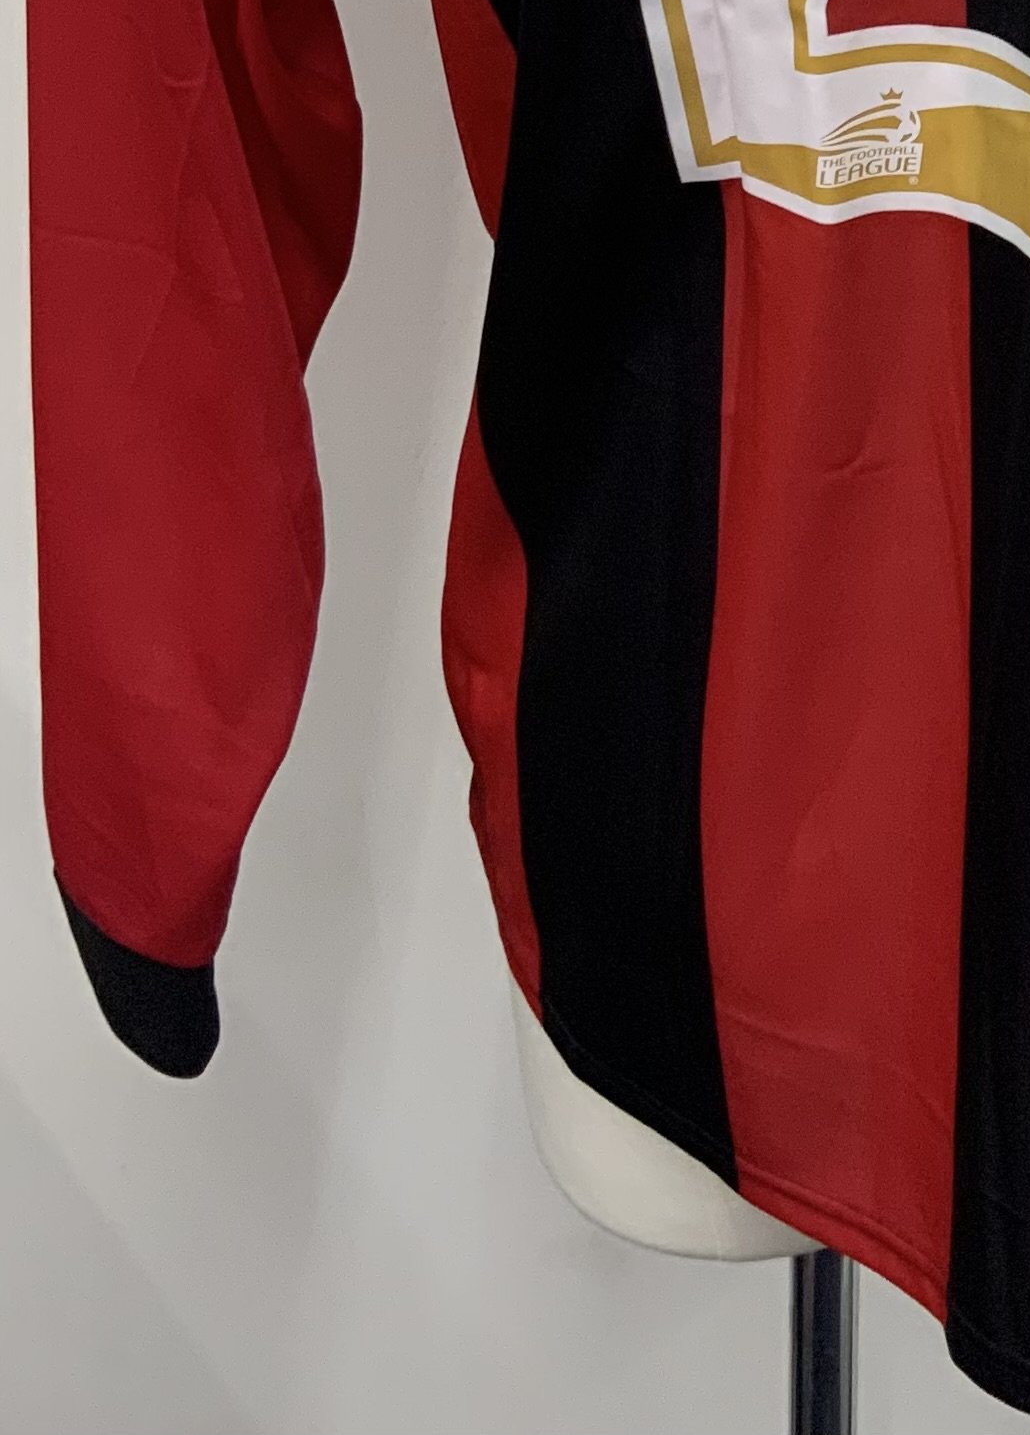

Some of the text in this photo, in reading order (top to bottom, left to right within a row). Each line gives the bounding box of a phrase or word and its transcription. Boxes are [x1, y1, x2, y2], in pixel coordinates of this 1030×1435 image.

[823, 146, 917, 168] THE FOOTBALL
[819, 156, 918, 186] LEAGUE
